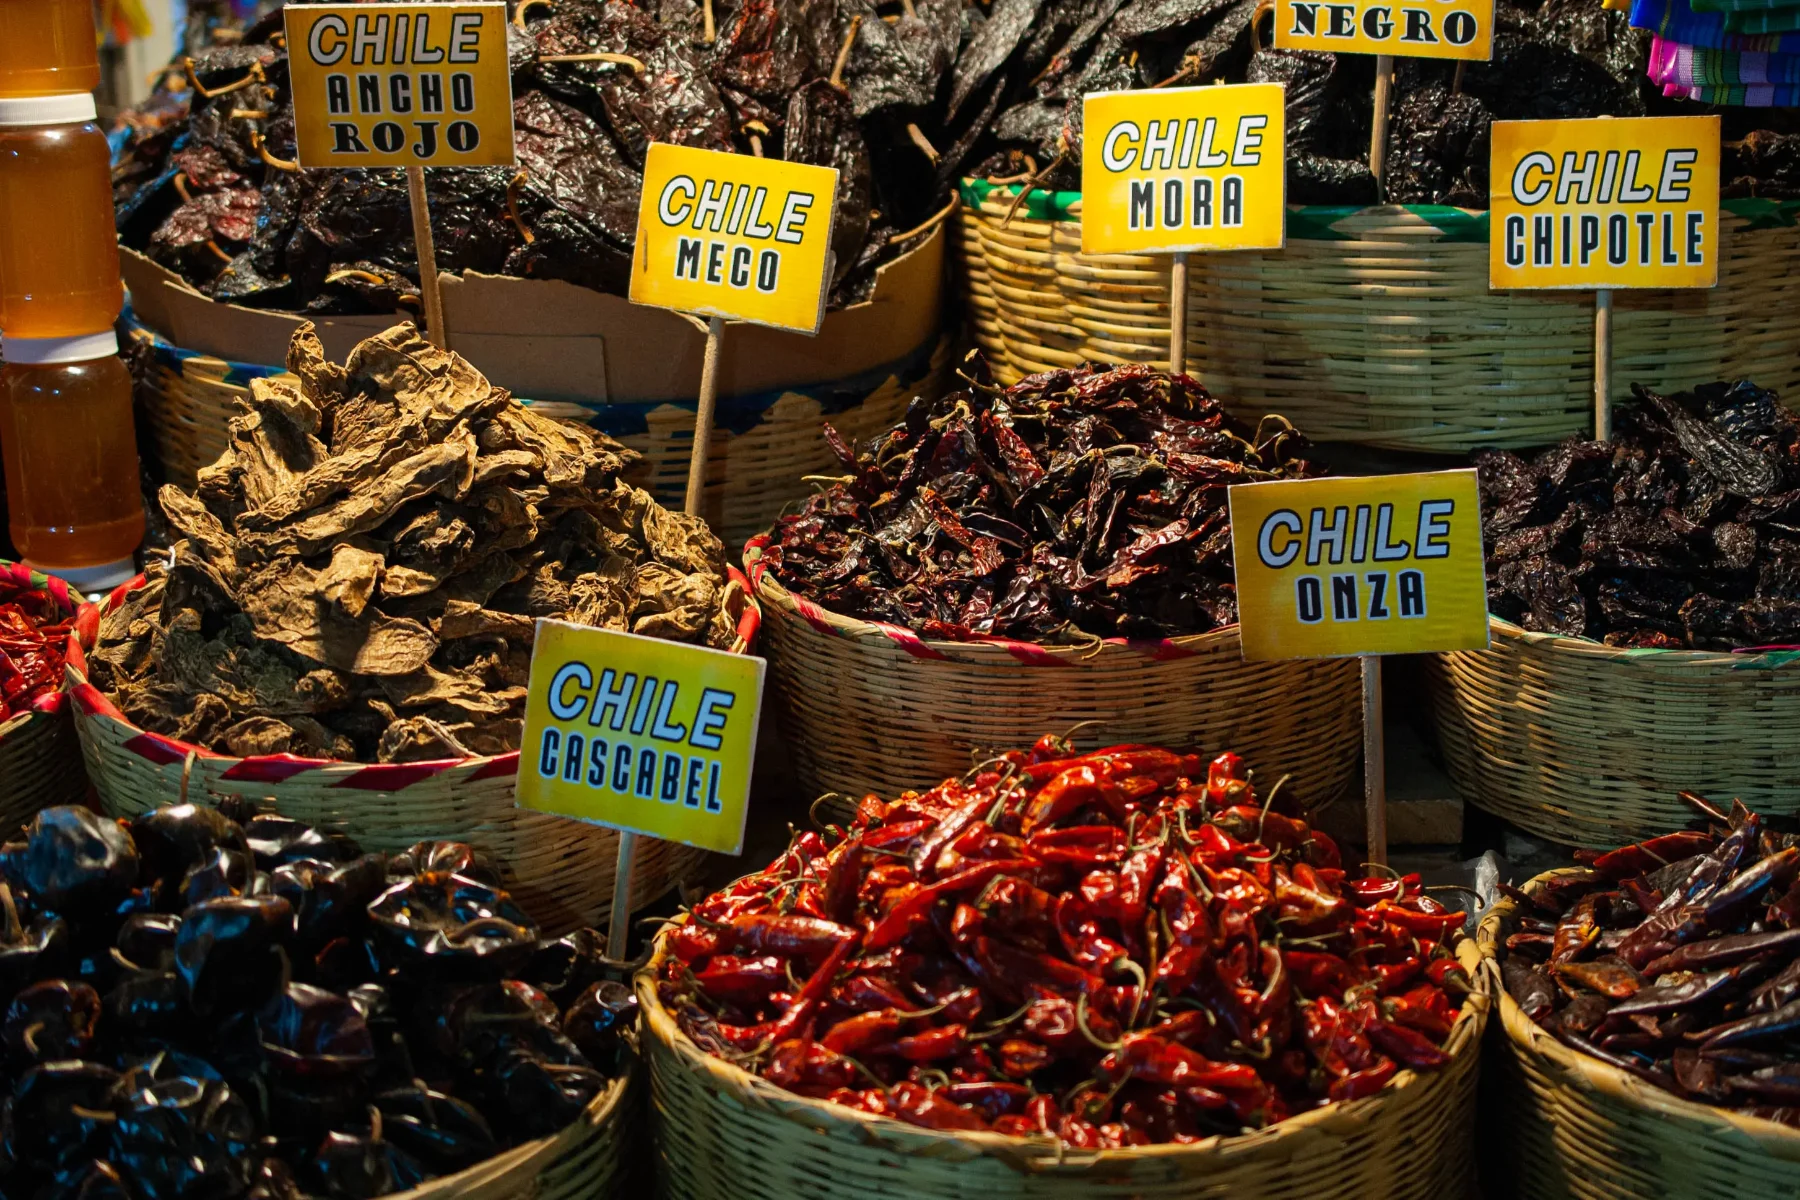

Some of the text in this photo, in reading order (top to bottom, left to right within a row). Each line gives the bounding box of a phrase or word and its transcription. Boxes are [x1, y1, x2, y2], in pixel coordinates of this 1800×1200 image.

[308, 13, 483, 66] CHILE
[1290, 2, 1477, 45] NEGRO
[326, 72, 475, 115] ANCHO
[329, 120, 480, 159] ROJO
[1102, 115, 1268, 172] CHILE
[1129, 174, 1243, 231] MORA
[1511, 148, 1698, 206] CHILE
[658, 174, 814, 244] CHILE
[674, 236, 780, 293] MECO
[1505, 211, 1704, 268] CHIPOTLE
[1257, 499, 1454, 569] CHILE
[1295, 568, 1426, 625] ONZA
[548, 661, 735, 750] CHILE
[539, 726, 722, 814] CASCABEL
